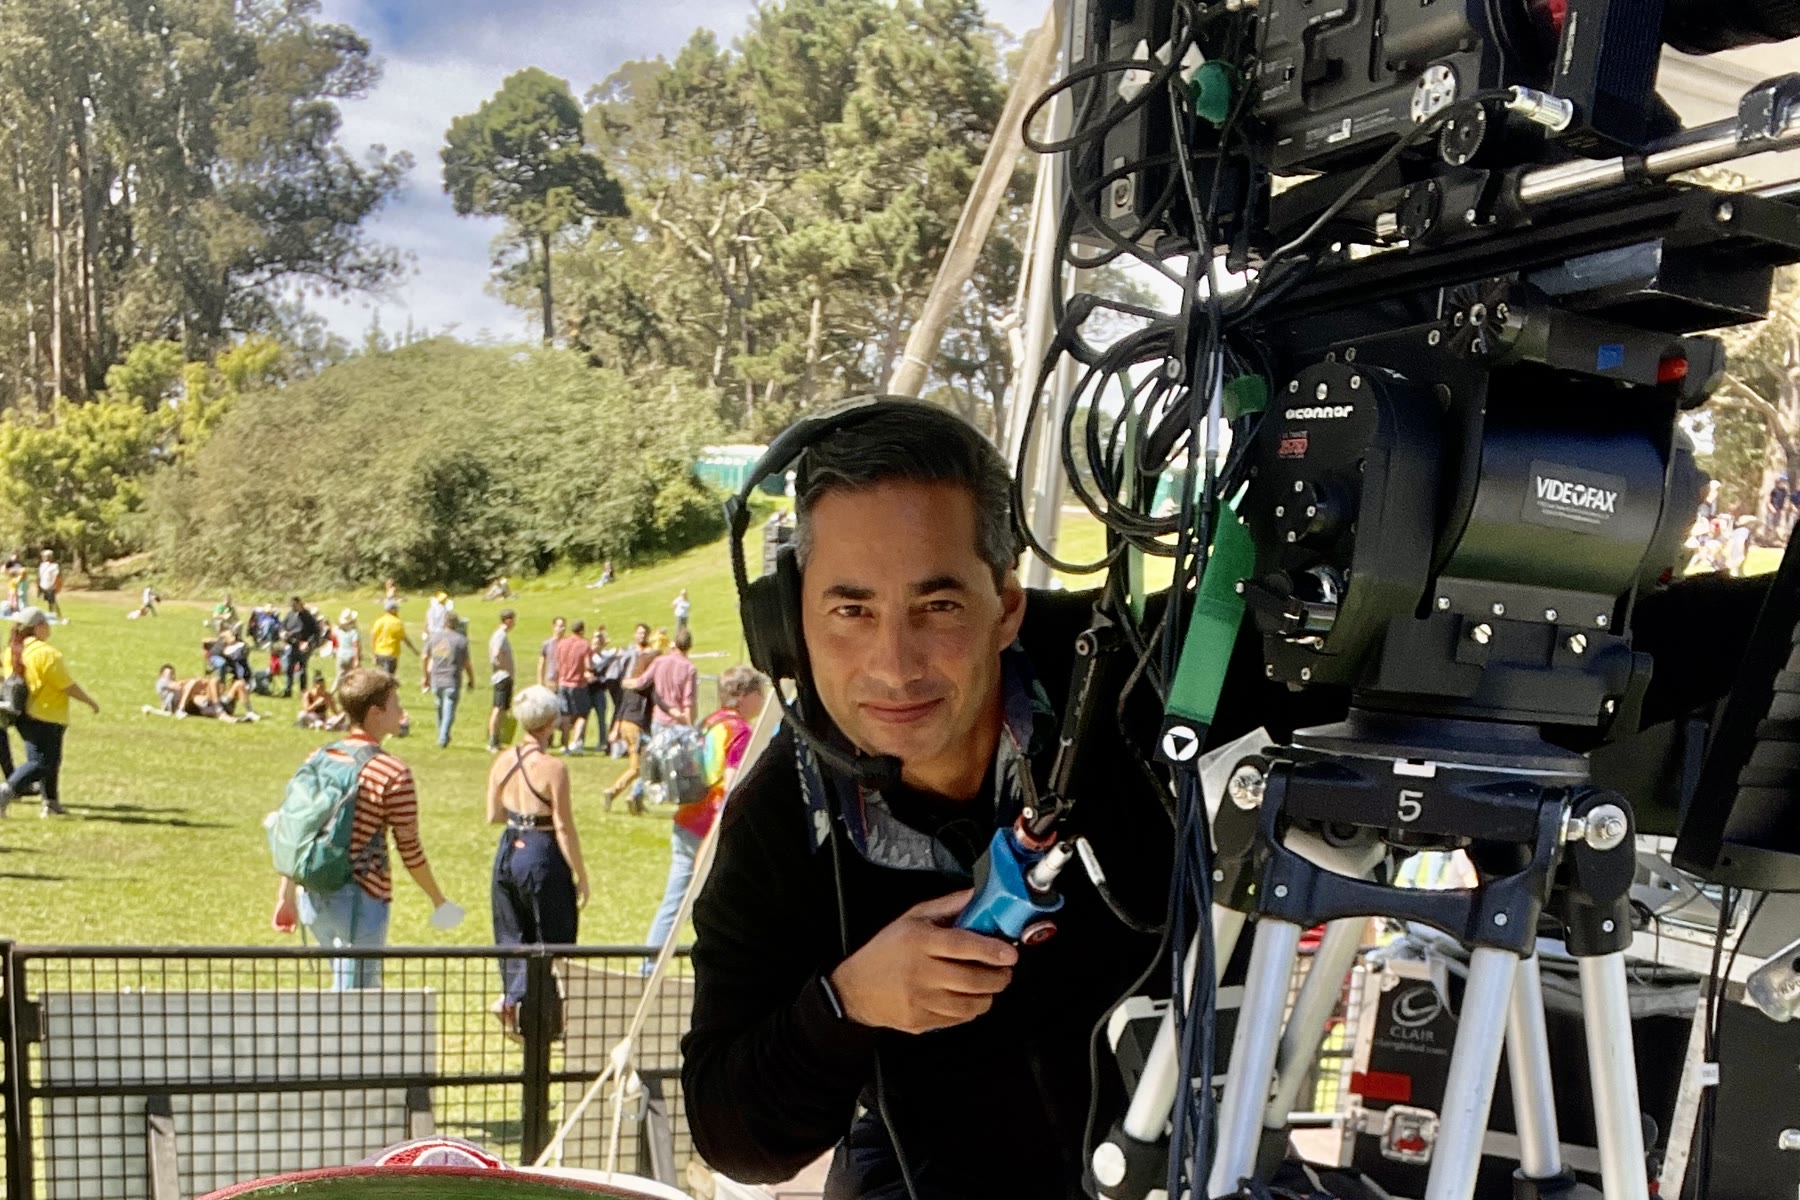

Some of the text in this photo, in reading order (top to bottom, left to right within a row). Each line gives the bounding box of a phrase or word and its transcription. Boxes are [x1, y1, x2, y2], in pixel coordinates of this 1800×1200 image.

[1537, 475, 1617, 513] VIDEOFAX
[1397, 789, 1424, 822] 5
[1389, 1025, 1435, 1042] CLAIR
